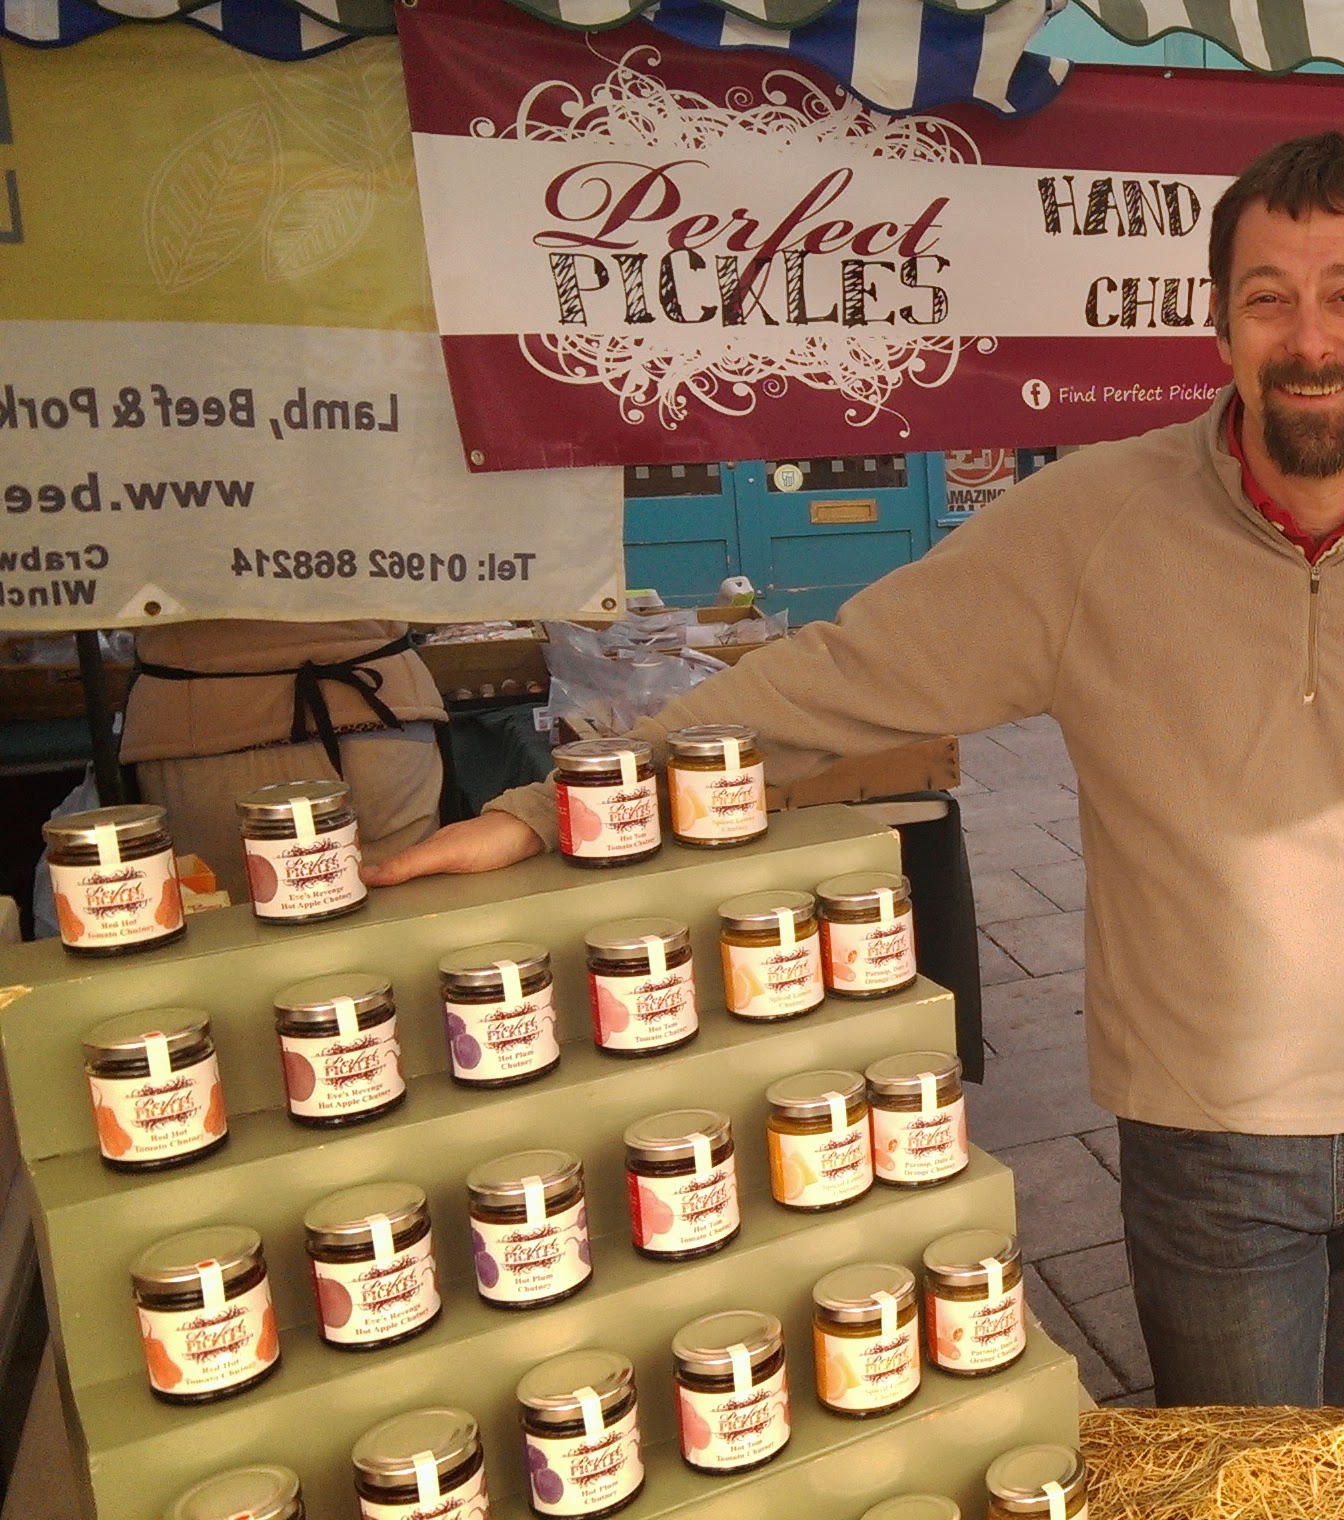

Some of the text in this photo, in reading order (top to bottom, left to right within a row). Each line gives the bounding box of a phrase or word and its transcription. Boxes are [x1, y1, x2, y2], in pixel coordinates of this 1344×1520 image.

[1037, 175, 1202, 237] HAND
[533, 160, 951, 311] Perfect
[548, 249, 951, 326] PICKLES
[1085, 276, 1216, 329] CHUT
[1059, 385, 1097, 404] Find
[1103, 383, 1163, 403] Perfect
[946, 488, 1006, 505] MAZIN
[608, 807, 651, 822] PICKLES
[610, 799, 651, 814] Perfect
[285, 862, 340, 878] PICKLES
[286, 852, 338, 871] Perfect
[86, 881, 142, 900] Perfect
[289, 886, 344, 902] Eve's Revenge
[281, 892, 352, 910] Hot Apple Chutney
[101, 919, 137, 930] Red Hot
[868, 936, 905, 951] Perfect
[769, 959, 809, 974] Perfect
[636, 986, 682, 1004] Perfect
[635, 996, 683, 1014] PICKLES
[487, 1023, 538, 1042] PICKLES
[488, 1015, 537, 1032] Perfect
[325, 1048, 378, 1067] Perfect
[498, 1050, 534, 1062] Hot Plum
[501, 1058, 533, 1071] Chutney
[324, 1058, 380, 1077] PICKLES
[135, 1090, 193, 1109] Perfect
[319, 1088, 391, 1110] Hot Apple Chutney
[327, 1083, 383, 1100] Eve's Revenge
[151, 1129, 188, 1143] Red Hot
[908, 1125, 951, 1141] Perfect
[822, 1145, 861, 1159] Perfect
[682, 1182, 726, 1204] Perfect
[681, 1193, 727, 1214] PICKLES
[504, 1243, 560, 1263] PICKLES
[505, 1237, 558, 1256] Perfect
[362, 1267, 417, 1289] Perfect
[515, 1273, 553, 1285] Hot Plum
[361, 1278, 418, 1302] PICKLES
[517, 1283, 551, 1293] Chutney
[975, 1309, 1014, 1326] Perfect
[186, 1318, 244, 1343] Perfect
[356, 1328, 371, 1336] Hot
[375, 1322, 398, 1333] Apple
[866, 1346, 908, 1363] Perfect
[719, 1402, 769, 1424] Perfect
[571, 1443, 622, 1466] Perfect
[570, 1452, 624, 1477] PICKLES
[581, 1488, 596, 1497] Hot
